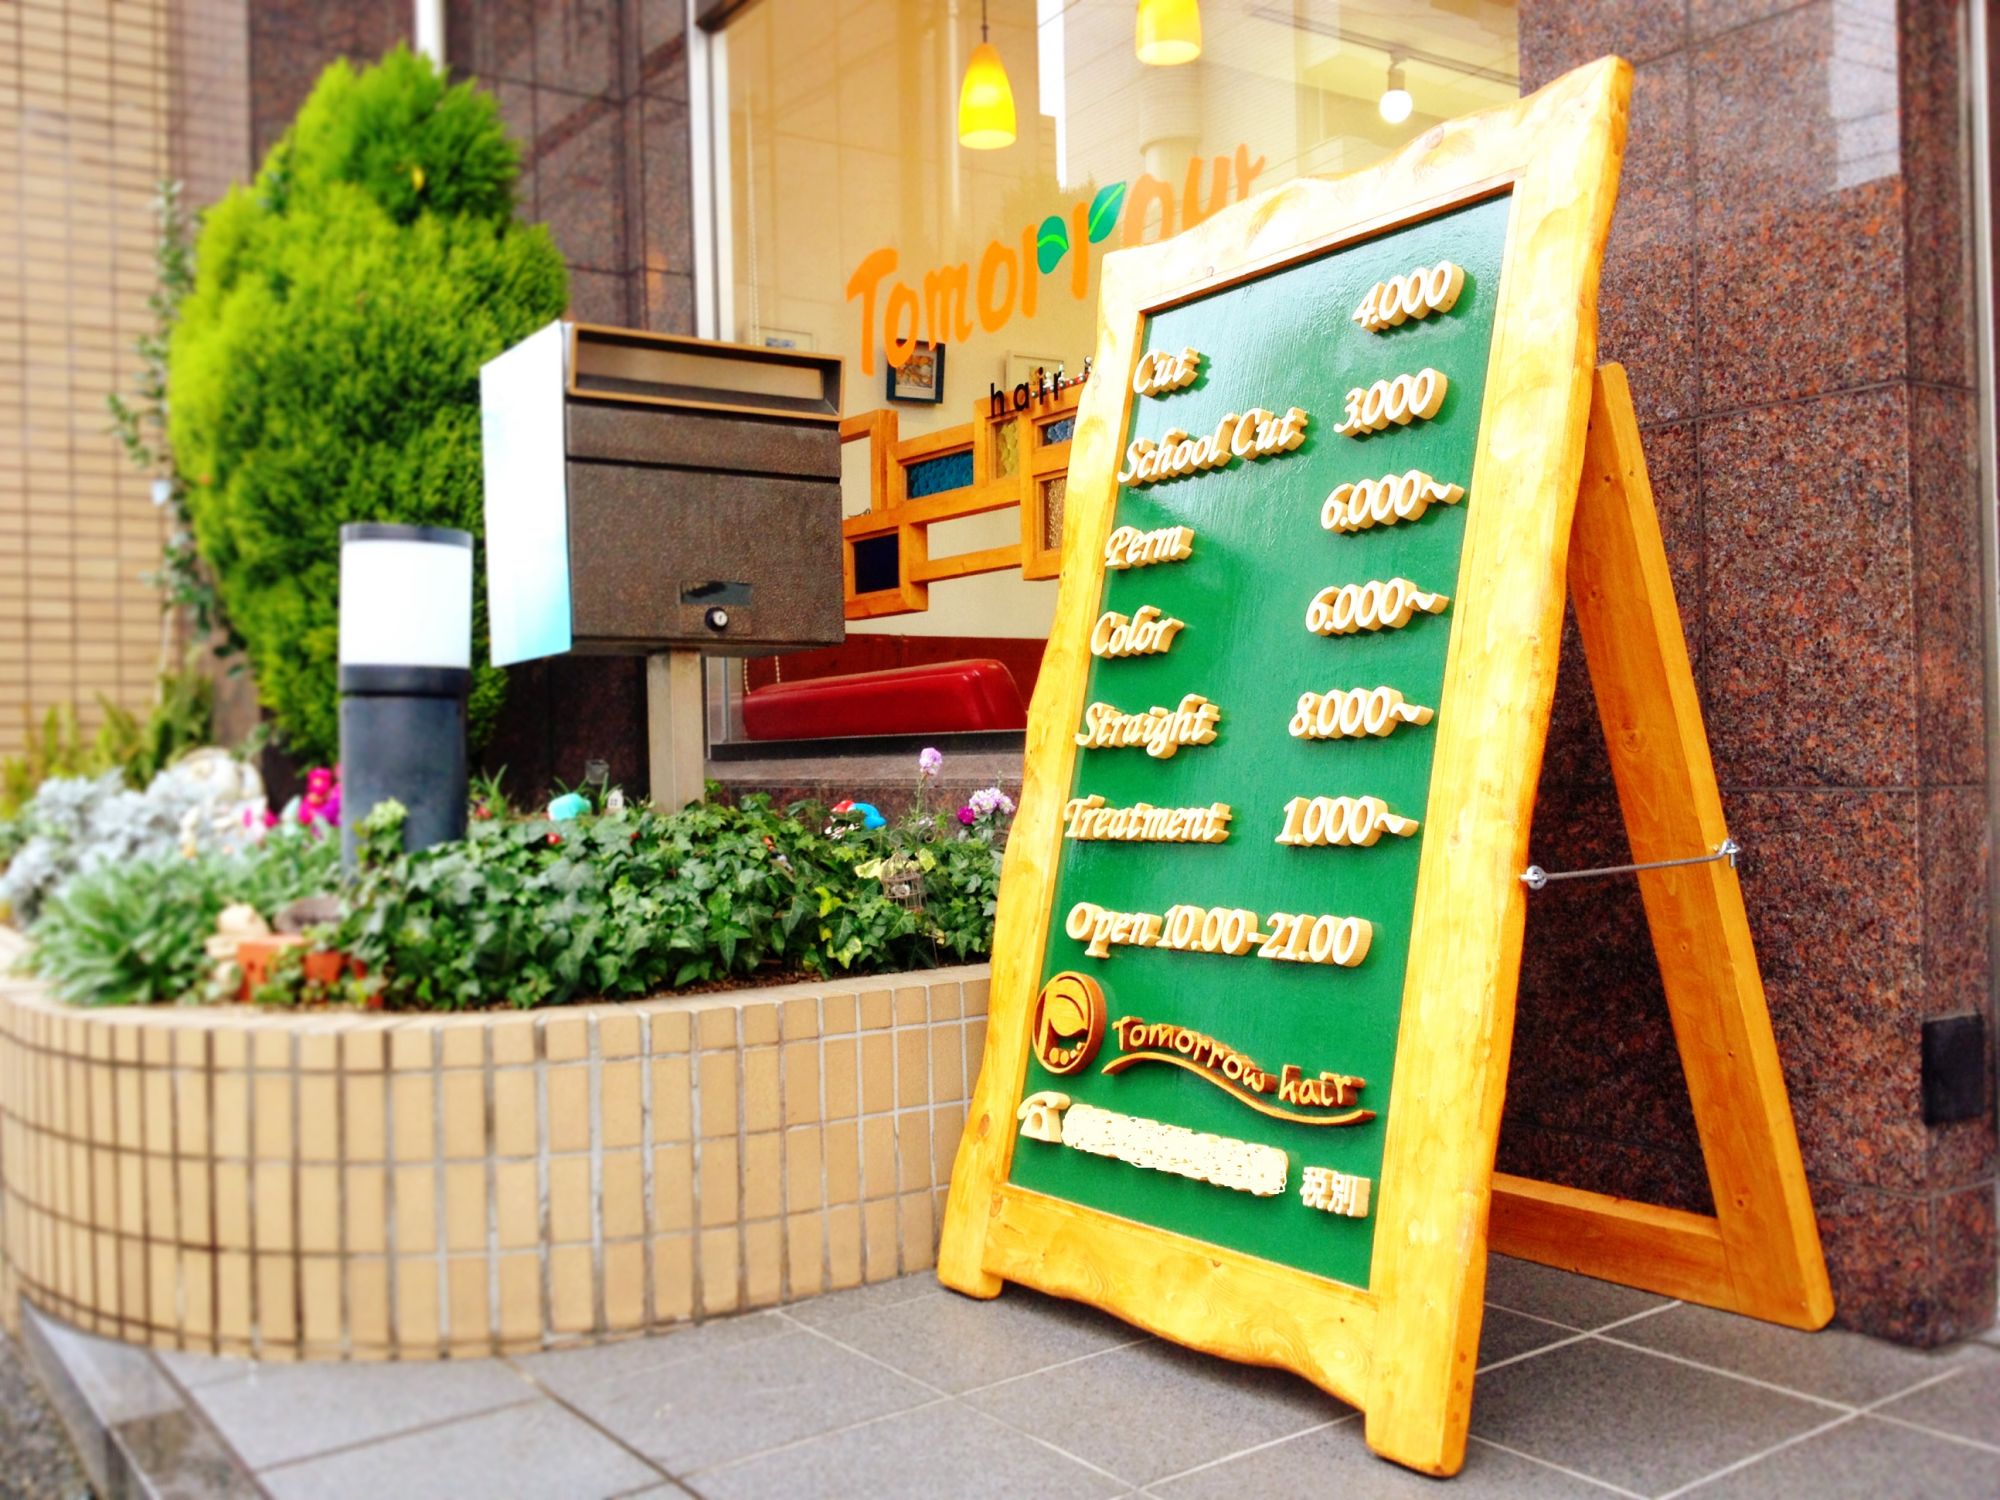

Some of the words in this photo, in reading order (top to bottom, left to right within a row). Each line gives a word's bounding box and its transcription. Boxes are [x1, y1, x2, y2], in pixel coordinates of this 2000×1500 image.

[1133, 347, 1200, 397] Cut
[1352, 260, 1465, 332] 4.000
[990, 366, 1062, 418] hair
[1117, 413, 1238, 486] School
[1231, 408, 1308, 459] Cut
[1334, 368, 1448, 437] 3.000
[1104, 526, 1195, 570] Perm
[1091, 606, 1184, 658] Color
[1075, 694, 1220, 759] Straight
[1063, 794, 1232, 843] Treatment
[1066, 902, 1161, 958] Open
[1112, 1016, 1279, 1093] Tomorrow
[1278, 1065, 1366, 1107] hair
[1300, 1166, 1370, 1218] 税別
